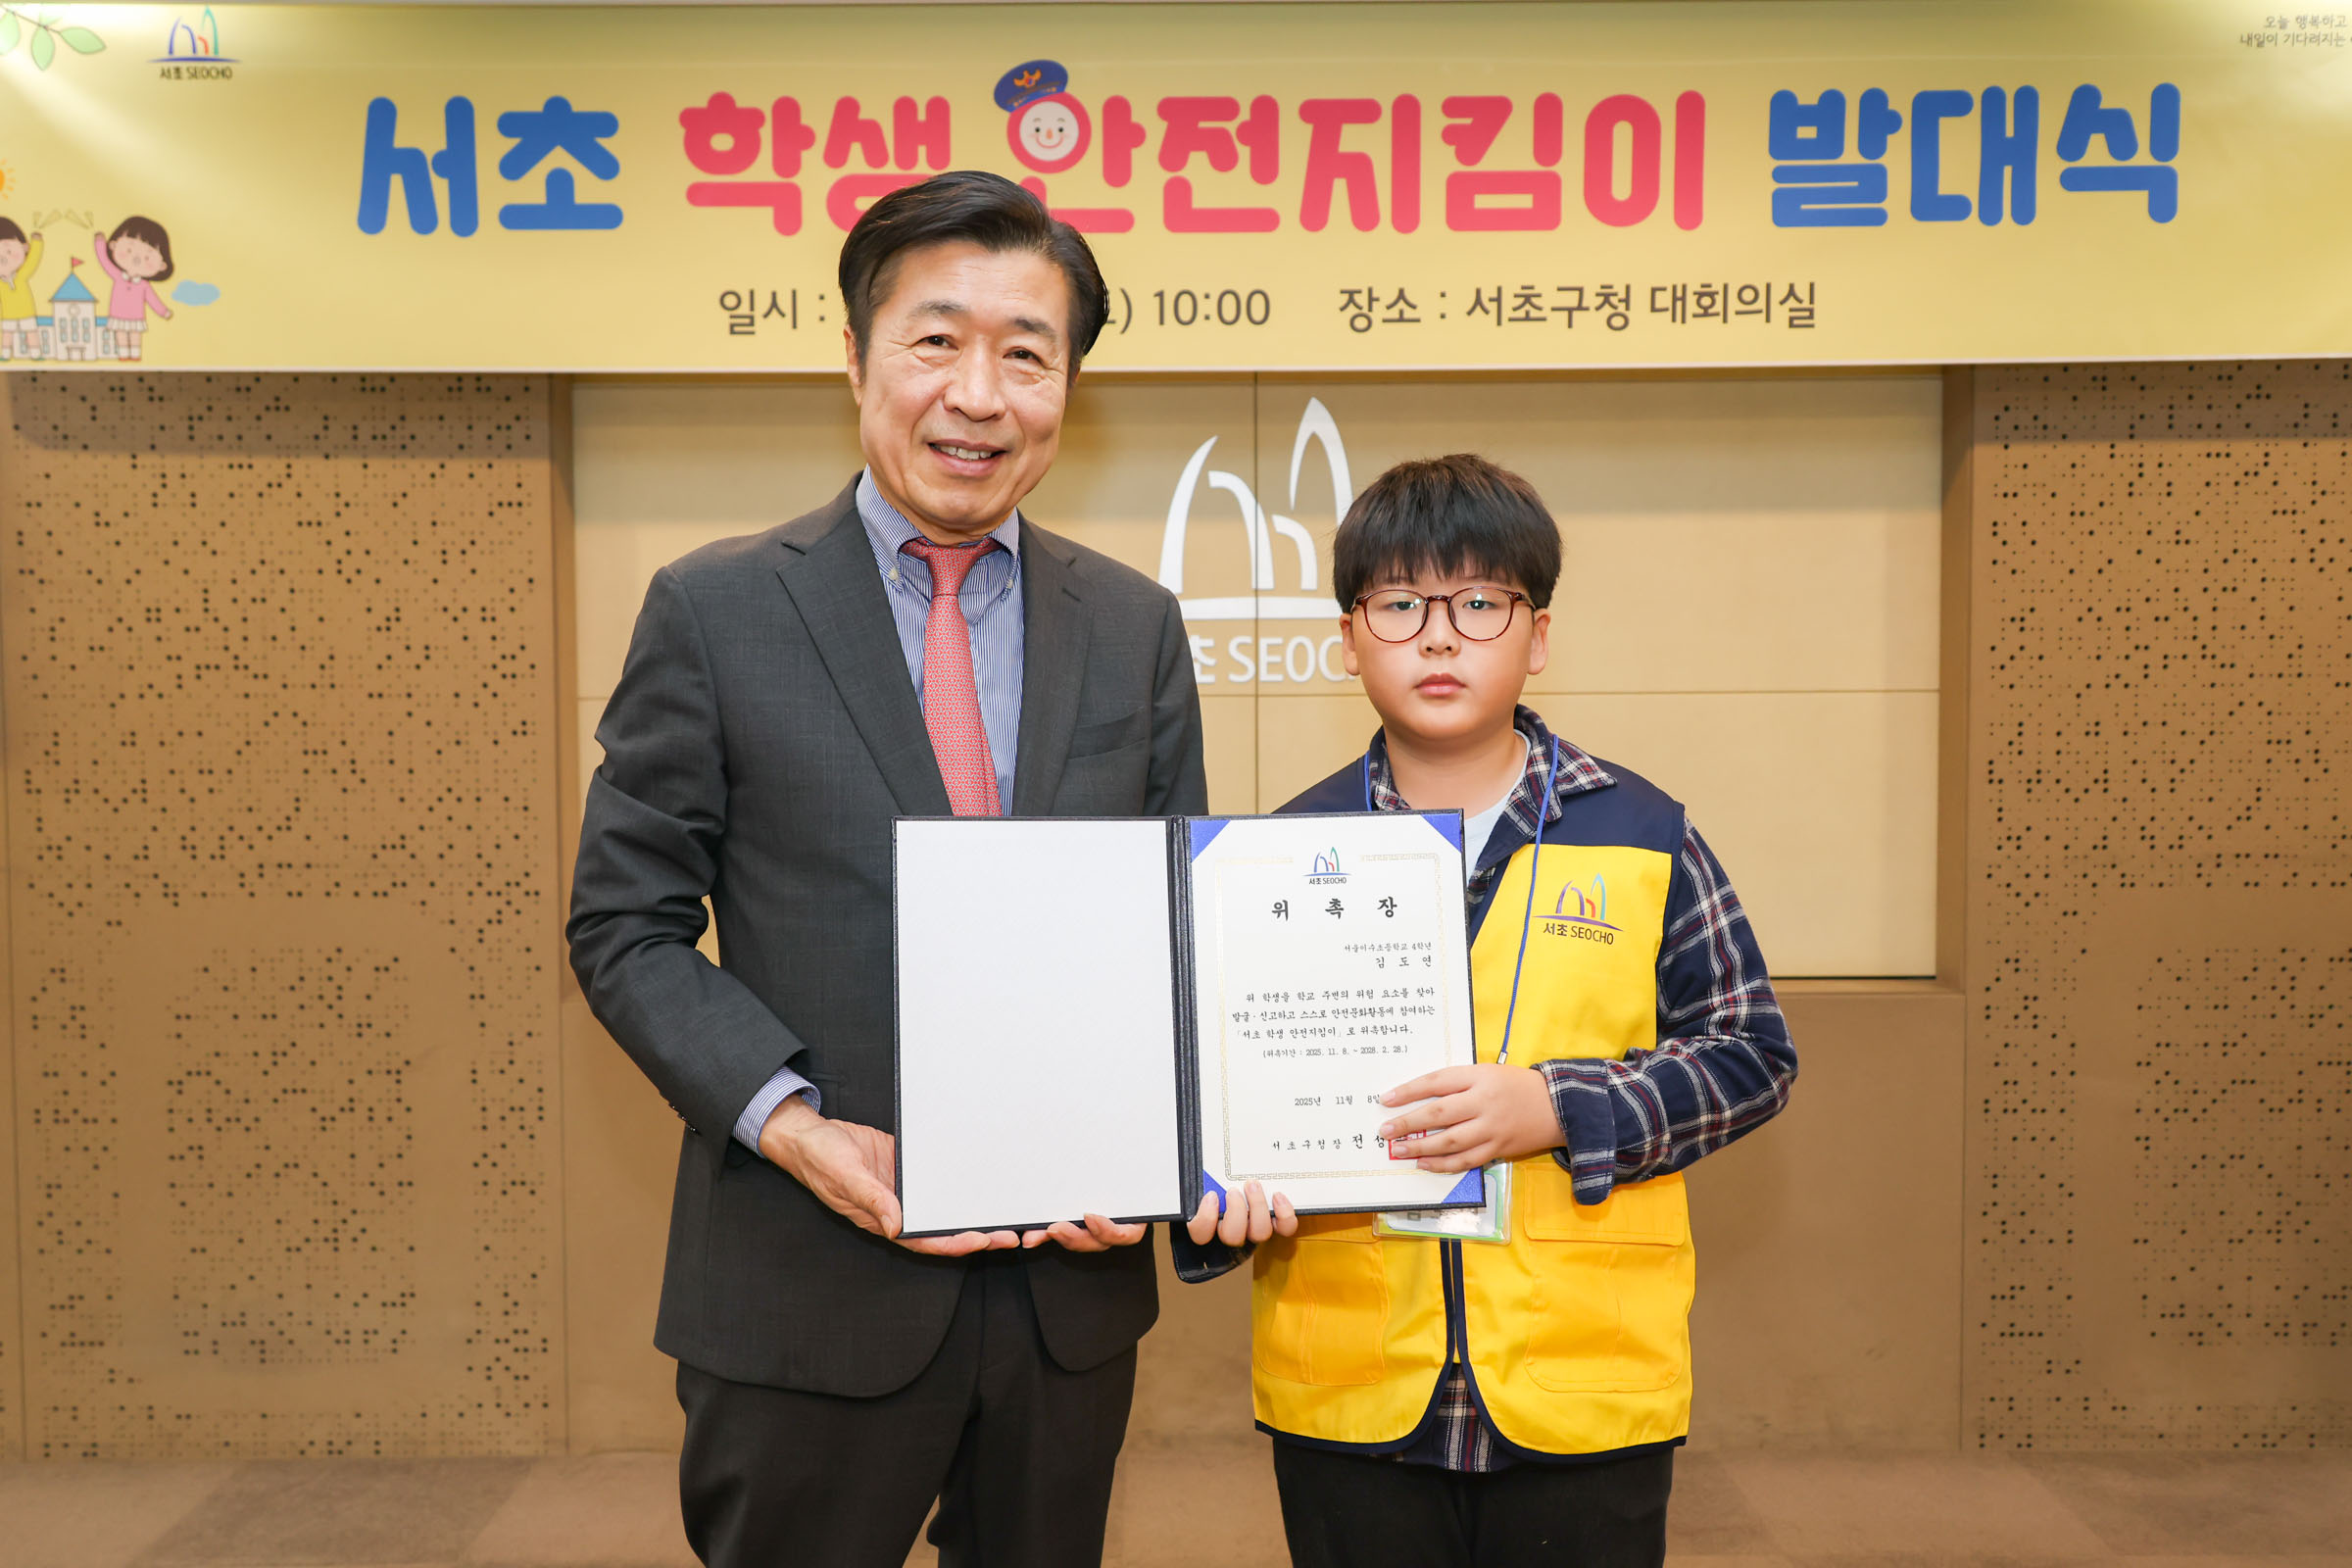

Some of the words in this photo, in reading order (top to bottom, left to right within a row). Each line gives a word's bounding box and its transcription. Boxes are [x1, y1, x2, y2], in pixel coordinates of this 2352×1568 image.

[2264, 16, 2289, 29] 오늘
[2295, 15, 2347, 29] 행복하고
[2239, 31, 2278, 47] 내일이
[2283, 31, 2346, 47] 기다려지는
[160, 66, 181, 79] 서초
[358, 95, 624, 237] 서초
[678, 92, 951, 236] 학생
[1006, 91, 1705, 234] 안전지킴이
[1767, 82, 2180, 227] 발대식
[719, 289, 798, 335] 일시
[1153, 289, 1270, 325] 10:00
[1339, 287, 1421, 332] 장소
[1466, 283, 1631, 330] 서초구청
[1650, 282, 1815, 328] 대회의실
[1186, 634, 1217, 684] 초
[1228, 635, 1357, 683] SEOC
[1543, 922, 1568, 937] 서초
[1570, 925, 1614, 945] SEOCHO
[1247, 993, 1254, 1003] 위
[1262, 992, 1290, 1003] 학생을
[1297, 992, 1315, 1001] 학교
[1322, 990, 1348, 1001] 주변의
[1356, 989, 1373, 1000] 위험
[1382, 988, 1408, 999] 요소를
[1417, 987, 1435, 998] 찾아
[1300, 1009, 1327, 1019] 스스로
[1400, 1005, 1435, 1016] 참여하는
[1266, 1029, 1284, 1040] 학생
[1360, 1024, 1413, 1036] 위촉합니다.
[1295, 1097, 1321, 1106] 2025년
[1336, 1095, 1353, 1105] 11월
